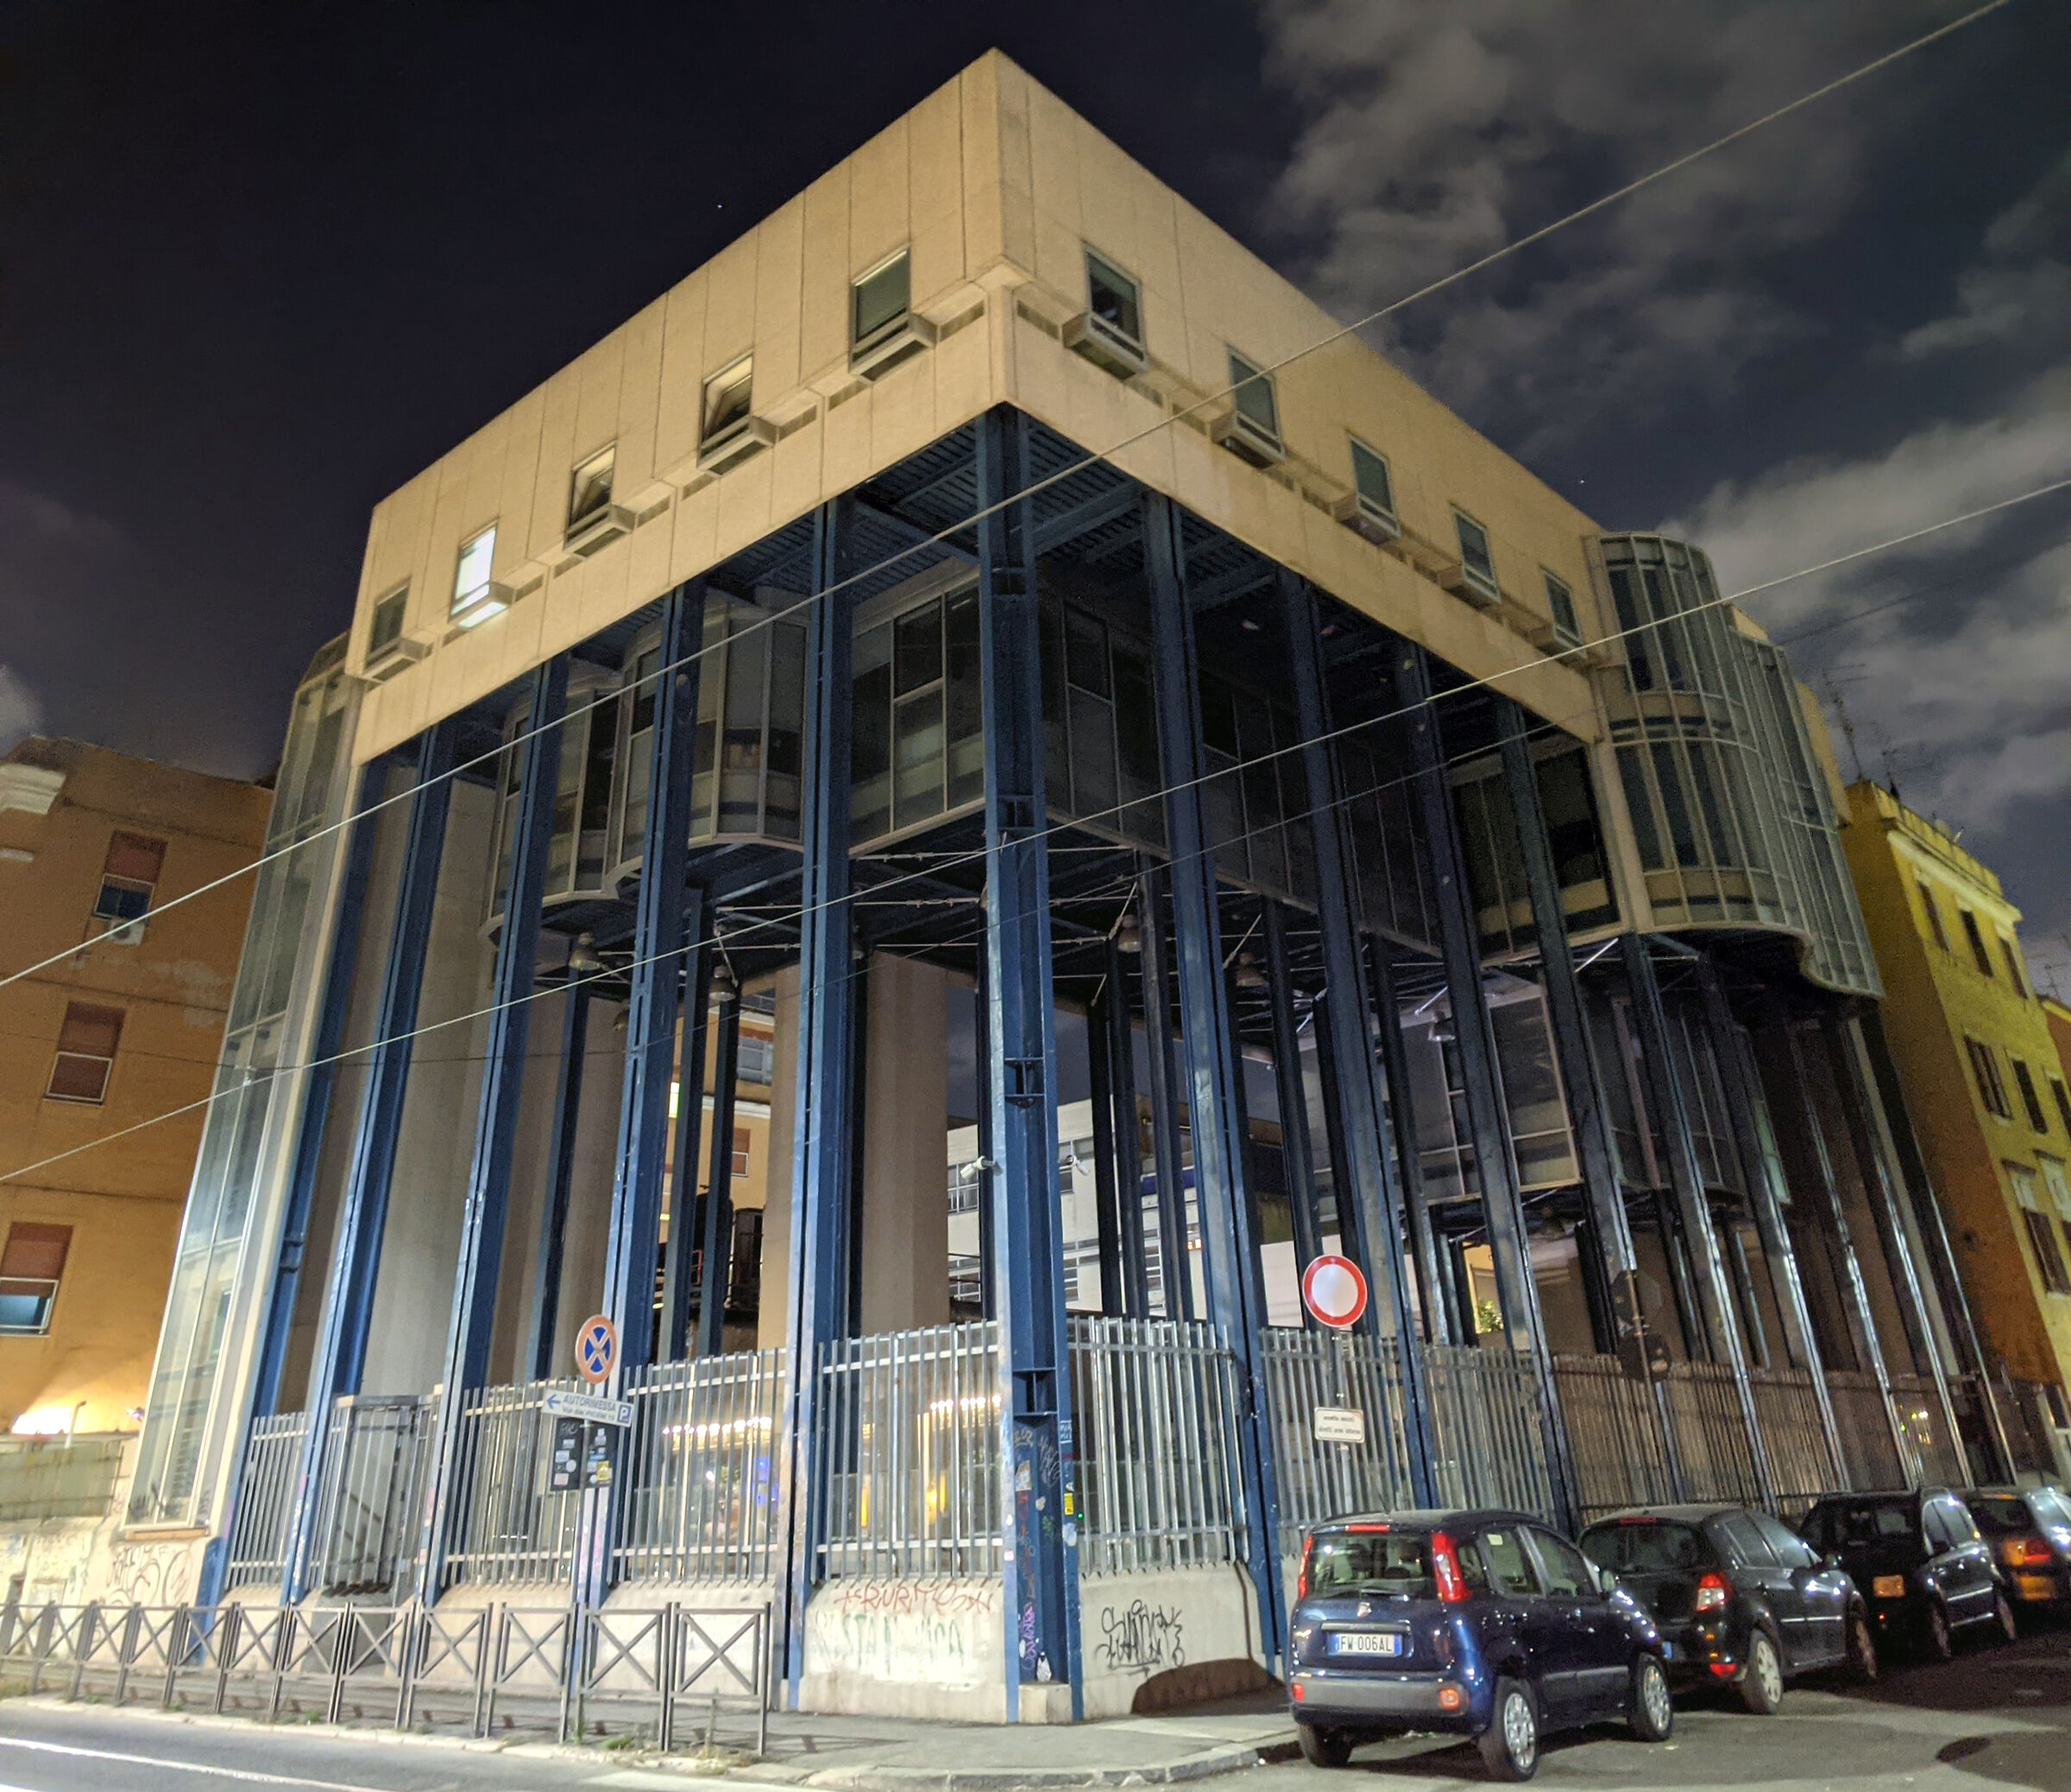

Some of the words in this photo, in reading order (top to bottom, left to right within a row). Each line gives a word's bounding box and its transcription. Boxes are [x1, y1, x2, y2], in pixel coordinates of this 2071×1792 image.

[563, 1394, 616, 1411] AUTORIMESSA
[1340, 1636, 1354, 1651] FW
[1357, 1636, 1393, 1651] 006AL
